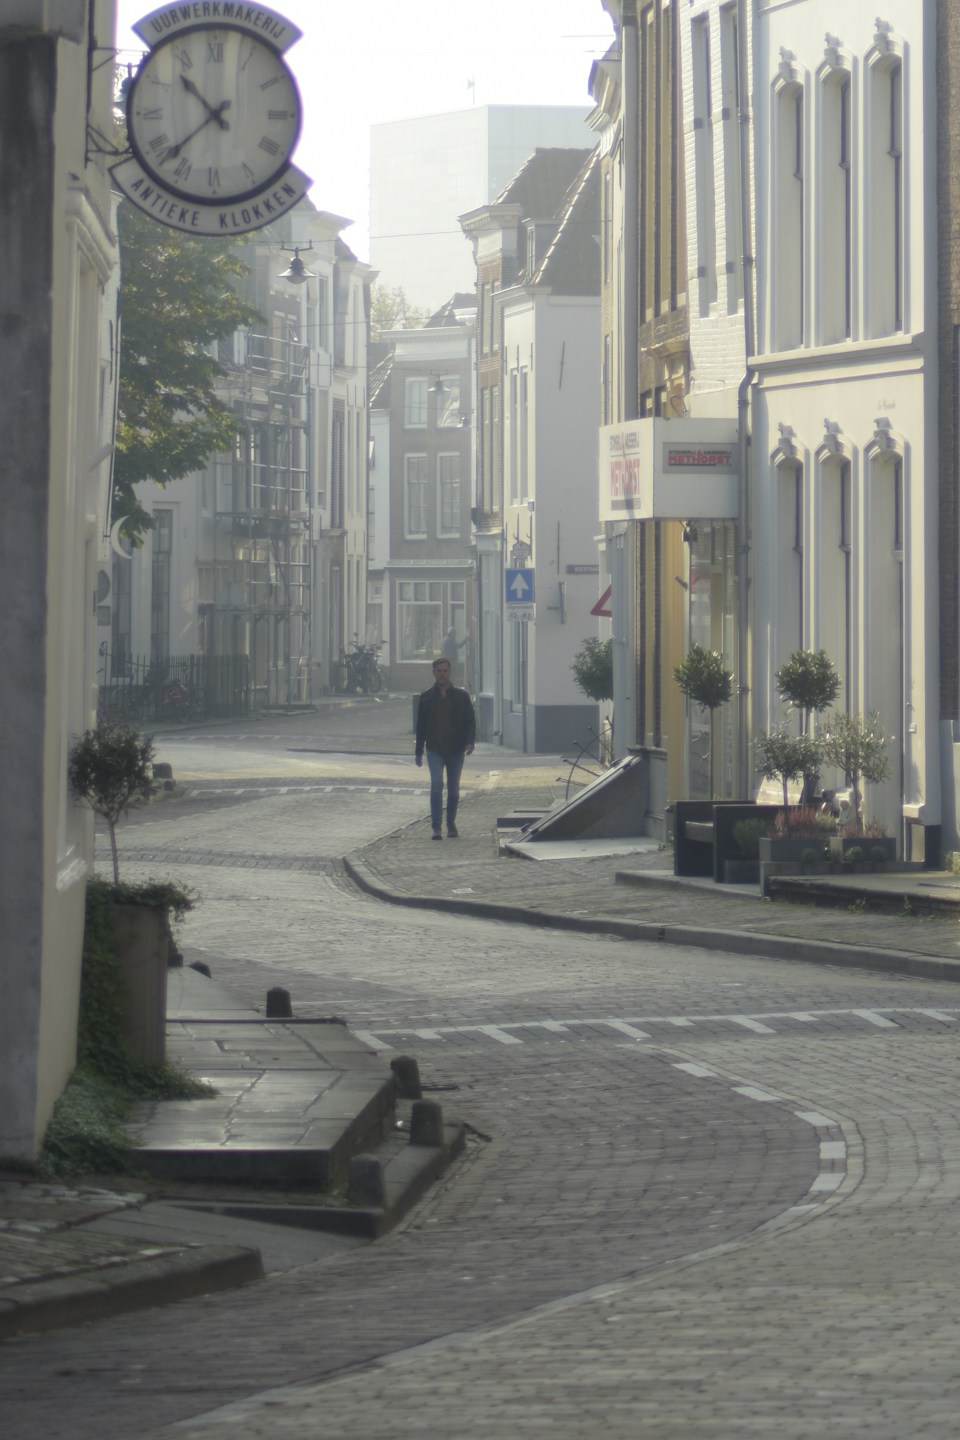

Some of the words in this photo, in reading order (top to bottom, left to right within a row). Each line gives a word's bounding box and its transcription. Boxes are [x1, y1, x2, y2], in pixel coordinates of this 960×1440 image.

[150, 1, 286, 39] UURWERKMAKERIJ
[131, 178, 200, 227] ANTIEKE
[219, 182, 297, 229] KLOKKEN
[668, 456, 732, 465] METHORST
